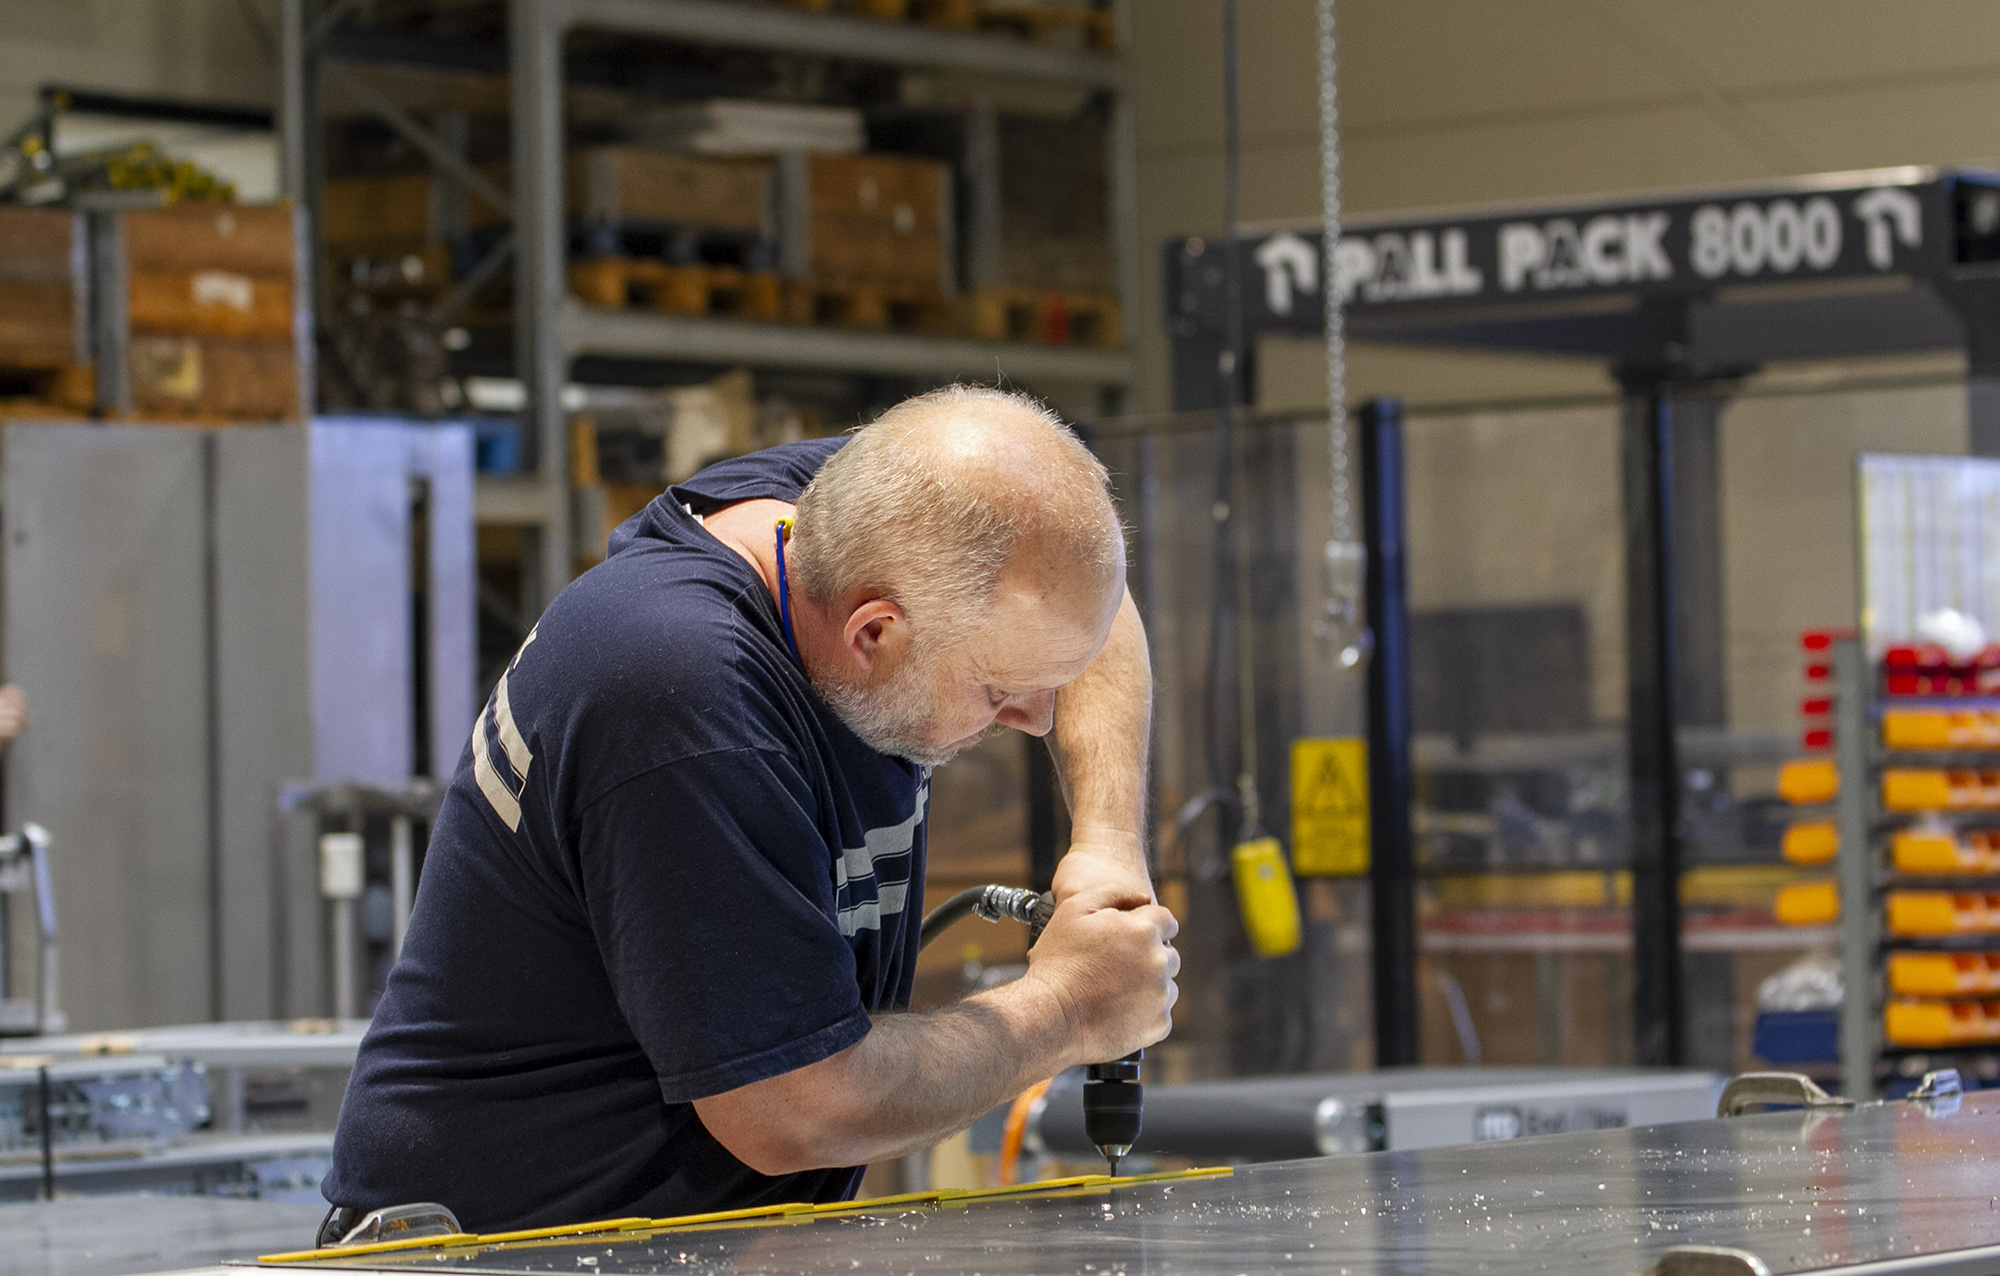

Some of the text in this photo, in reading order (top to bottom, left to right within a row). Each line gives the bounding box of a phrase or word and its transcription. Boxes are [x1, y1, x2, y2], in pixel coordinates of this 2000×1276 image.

[1328, 197, 1842, 302] PALL PACK 8000
